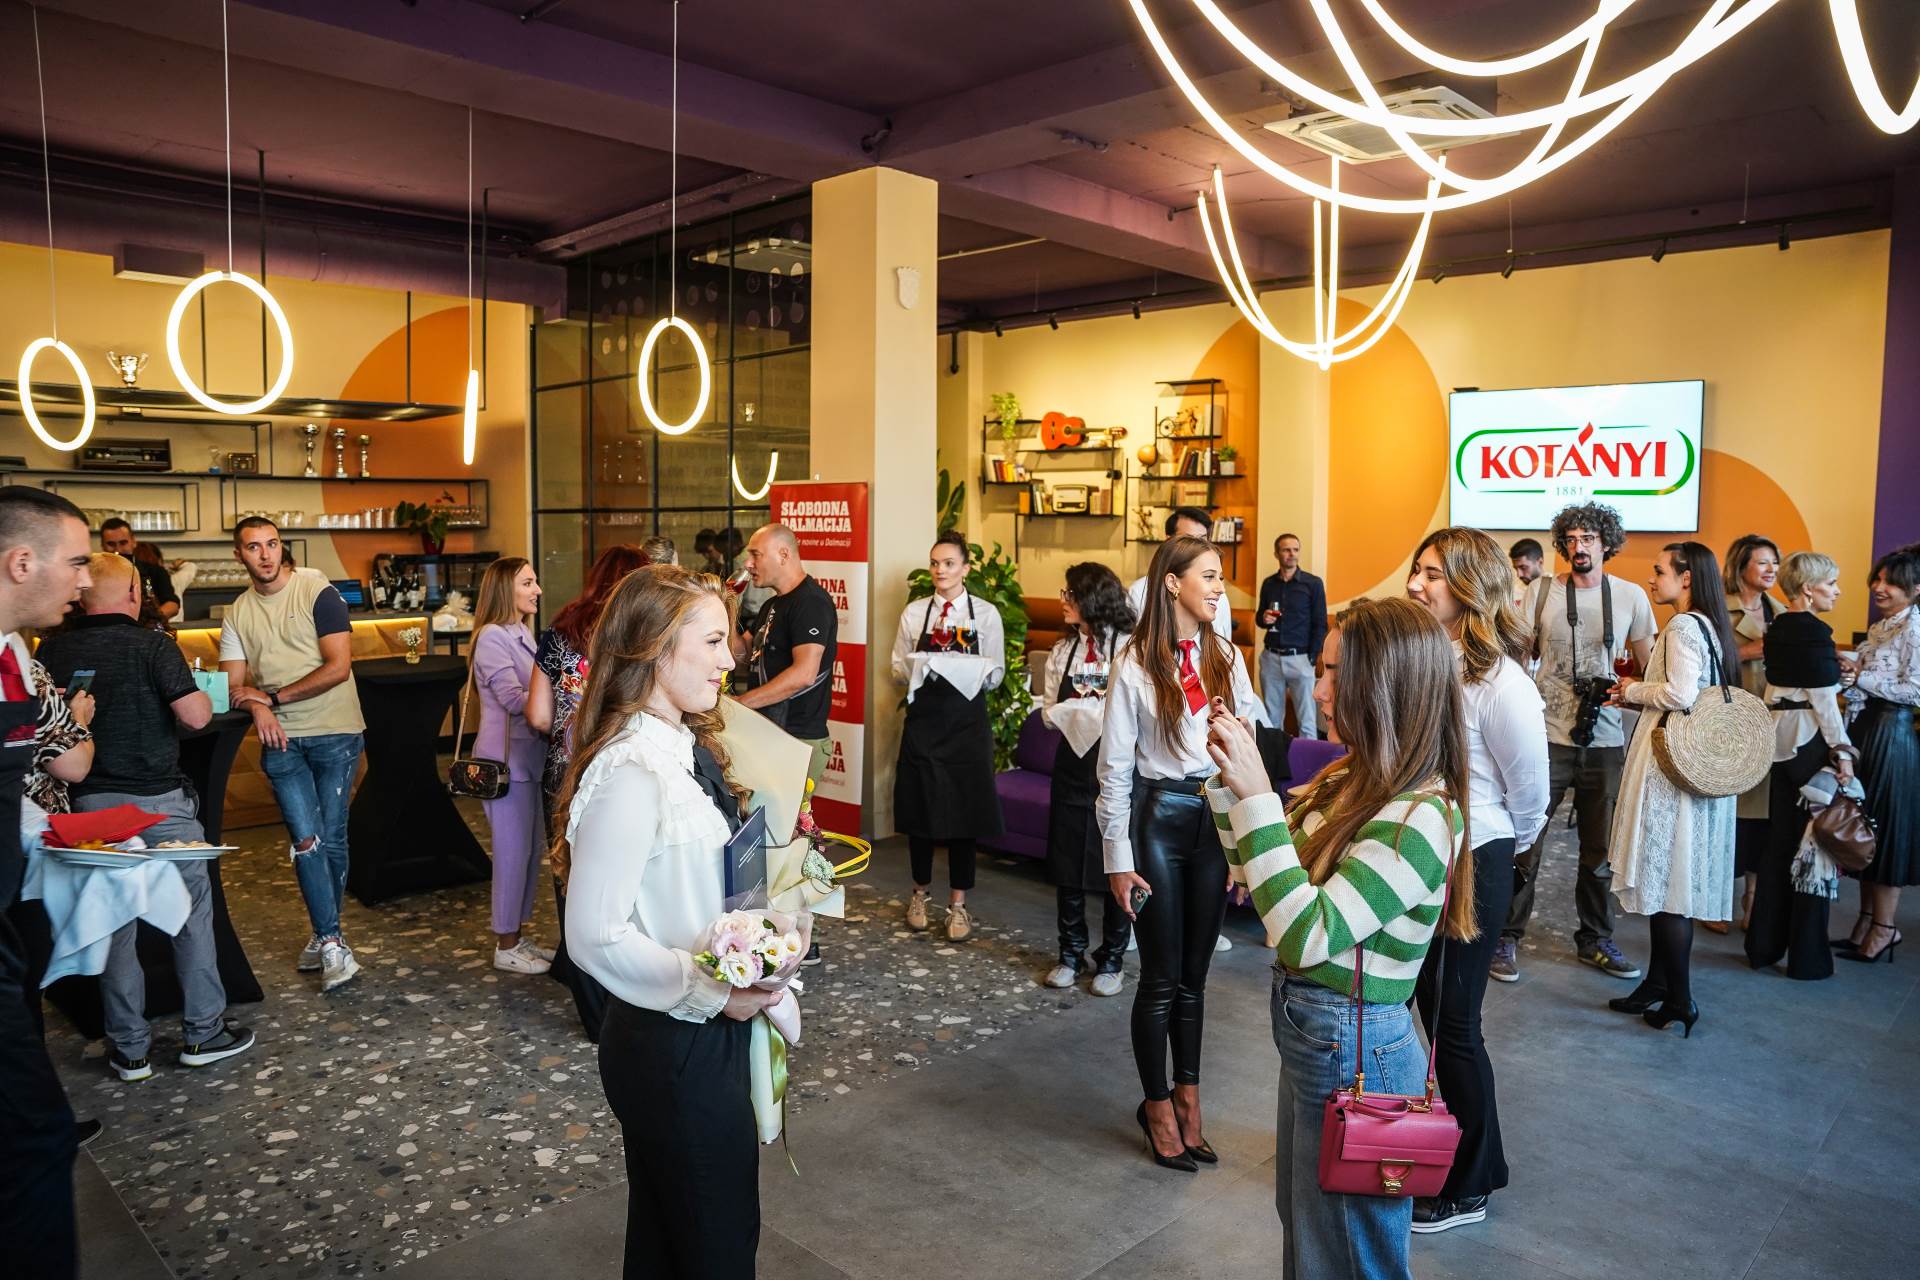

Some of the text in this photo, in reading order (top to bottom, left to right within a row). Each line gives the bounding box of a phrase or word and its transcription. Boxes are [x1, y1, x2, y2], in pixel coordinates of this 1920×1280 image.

[1481, 422, 1667, 478] KOTÁNYI
[1556, 486, 1583, 496] 1881
[781, 501, 849, 516] SLOBODNA
[781, 518, 852, 532] DALMACIJA
